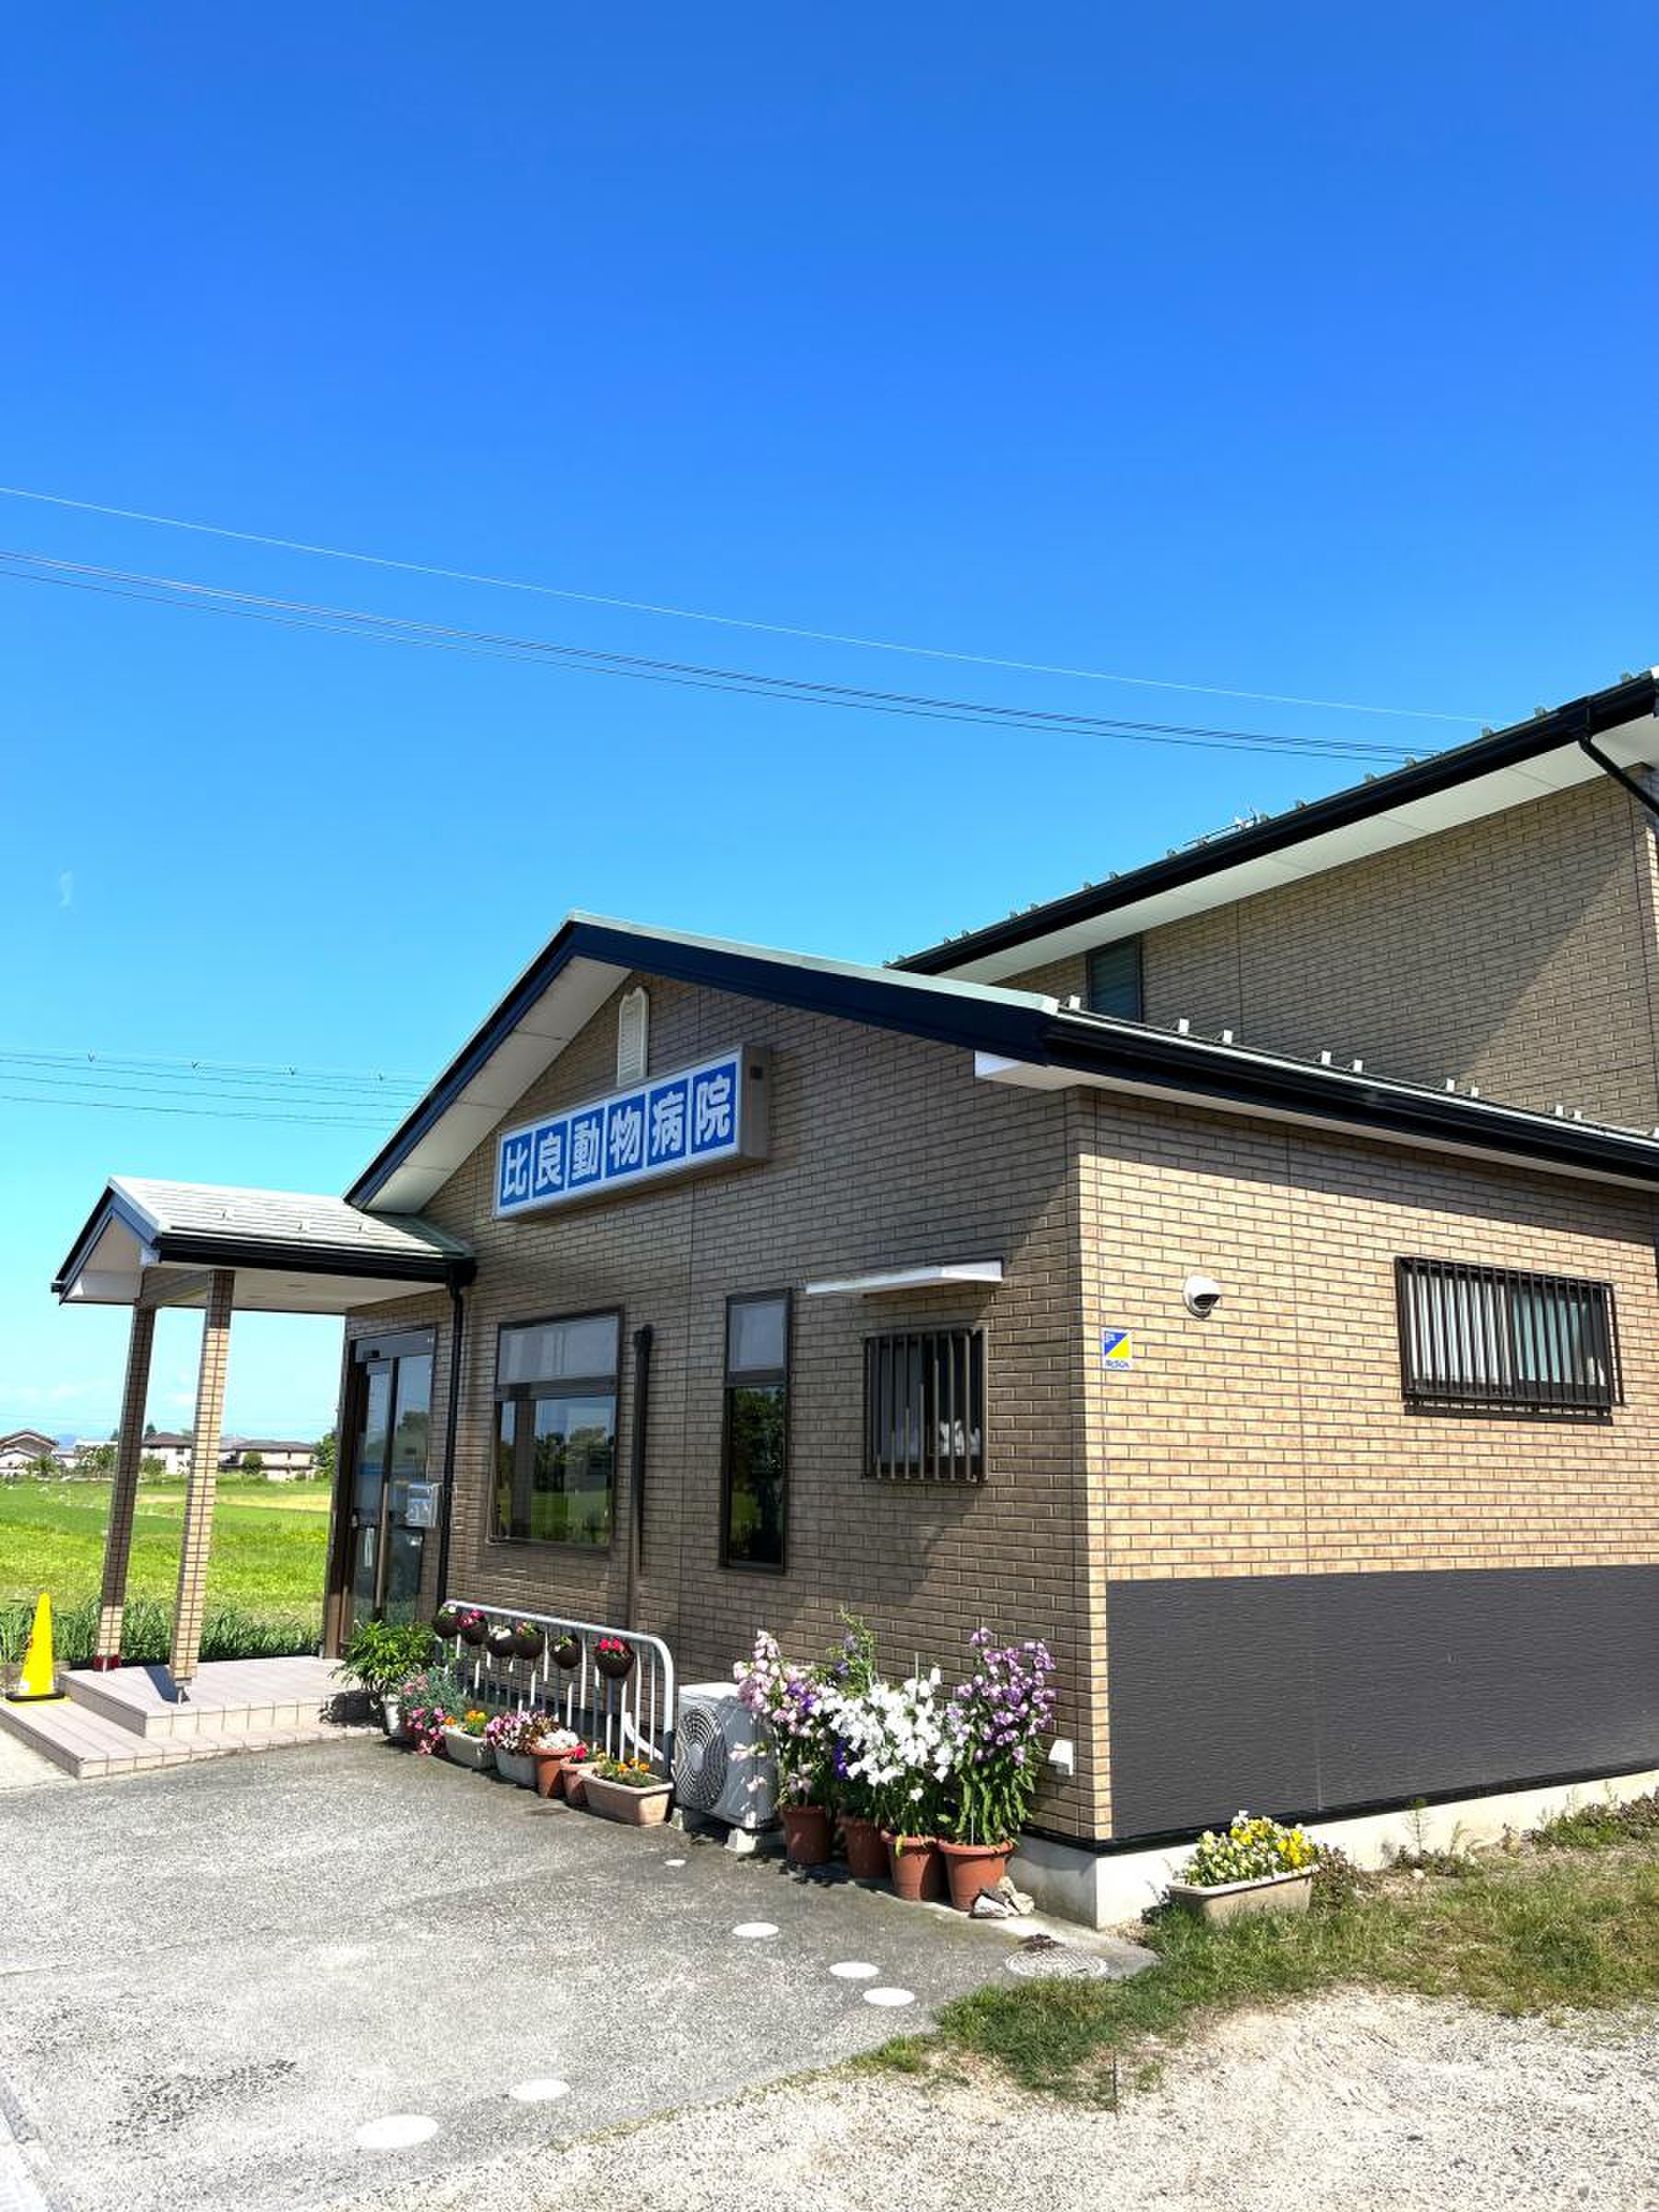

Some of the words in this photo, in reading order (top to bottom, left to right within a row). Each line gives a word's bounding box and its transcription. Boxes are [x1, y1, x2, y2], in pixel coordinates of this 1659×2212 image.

[502, 1074, 731, 1198] 比良動物病院
